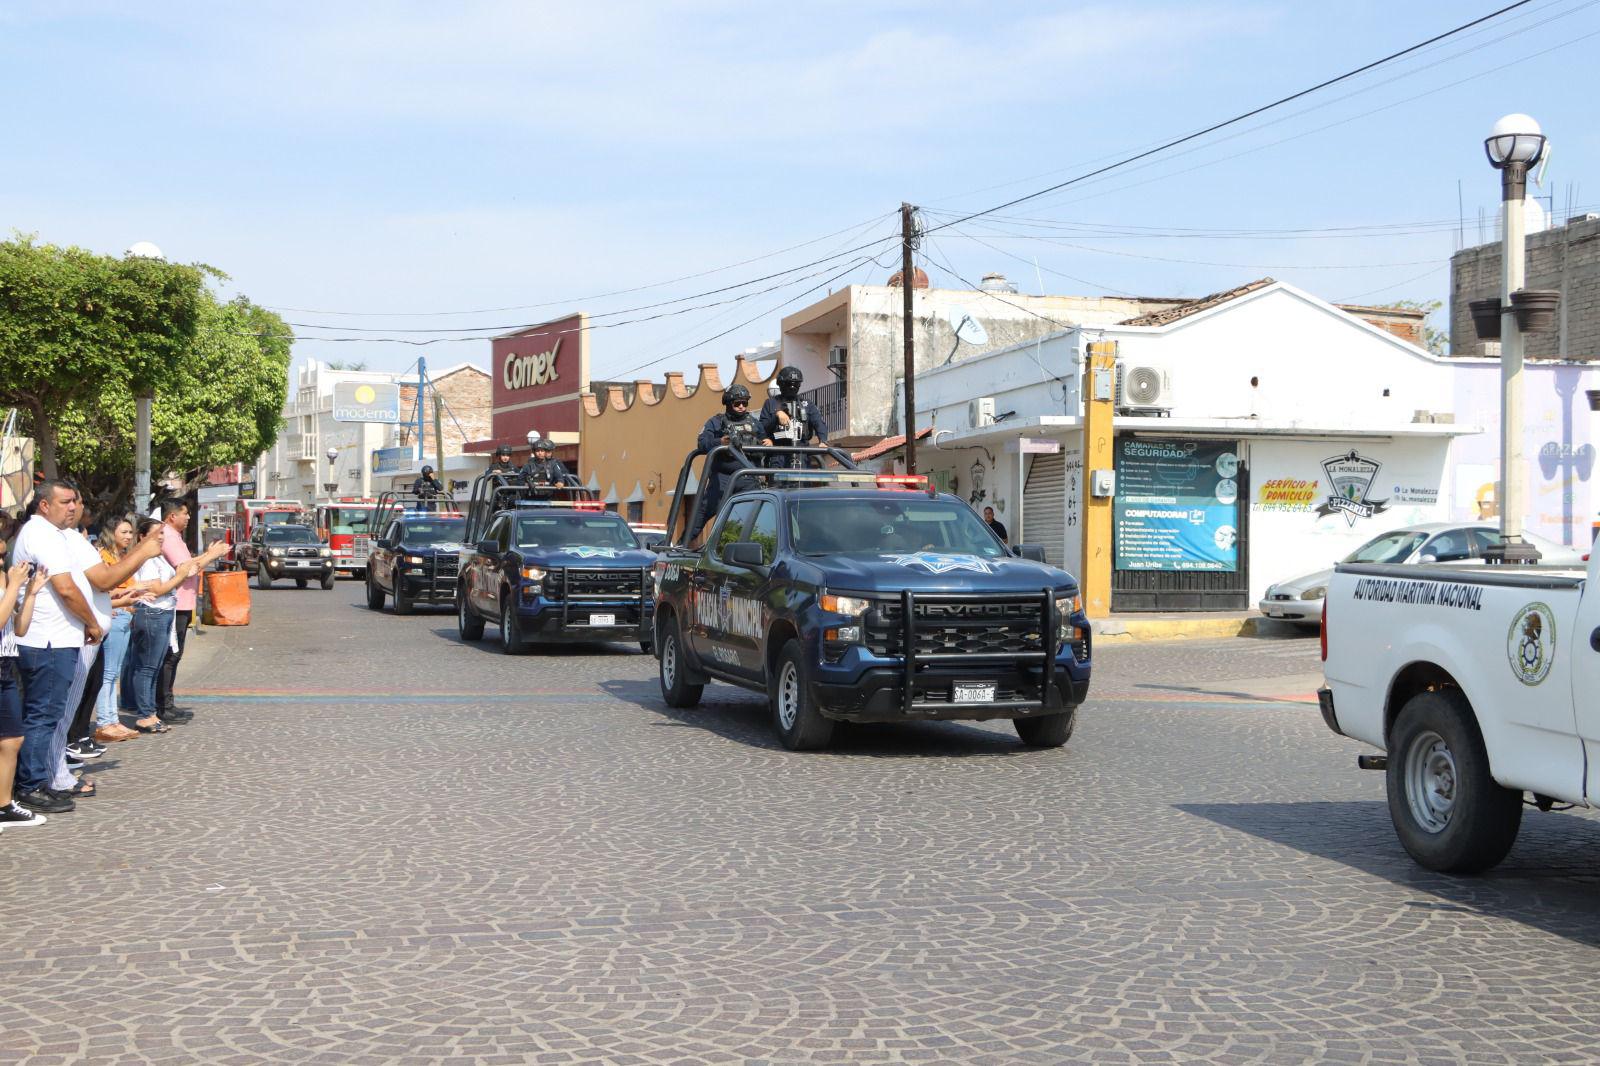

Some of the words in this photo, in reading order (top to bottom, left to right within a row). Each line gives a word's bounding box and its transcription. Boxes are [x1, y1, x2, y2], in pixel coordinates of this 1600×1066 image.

[504, 337, 563, 390] Comex
[336, 407, 396, 420] moderno
[1124, 448, 1184, 458] SEGURIDAD
[1264, 479, 1306, 489] SERVICIO
[1312, 480, 1319, 489] A
[1265, 490, 1314, 501] DOMICILIO
[1125, 509, 1188, 519] COMPUTADORAS
[1332, 498, 1368, 517] PIZZERIA
[551, 572, 642, 580] CHEVROLE
[1353, 579, 1398, 602] AUTORIDAD
[1396, 580, 1438, 605] MARITIMA
[1437, 583, 1483, 610] NACIONAL
[884, 603, 1042, 617] CHEVROLE
[731, 595, 763, 640] MUNICIPAL
